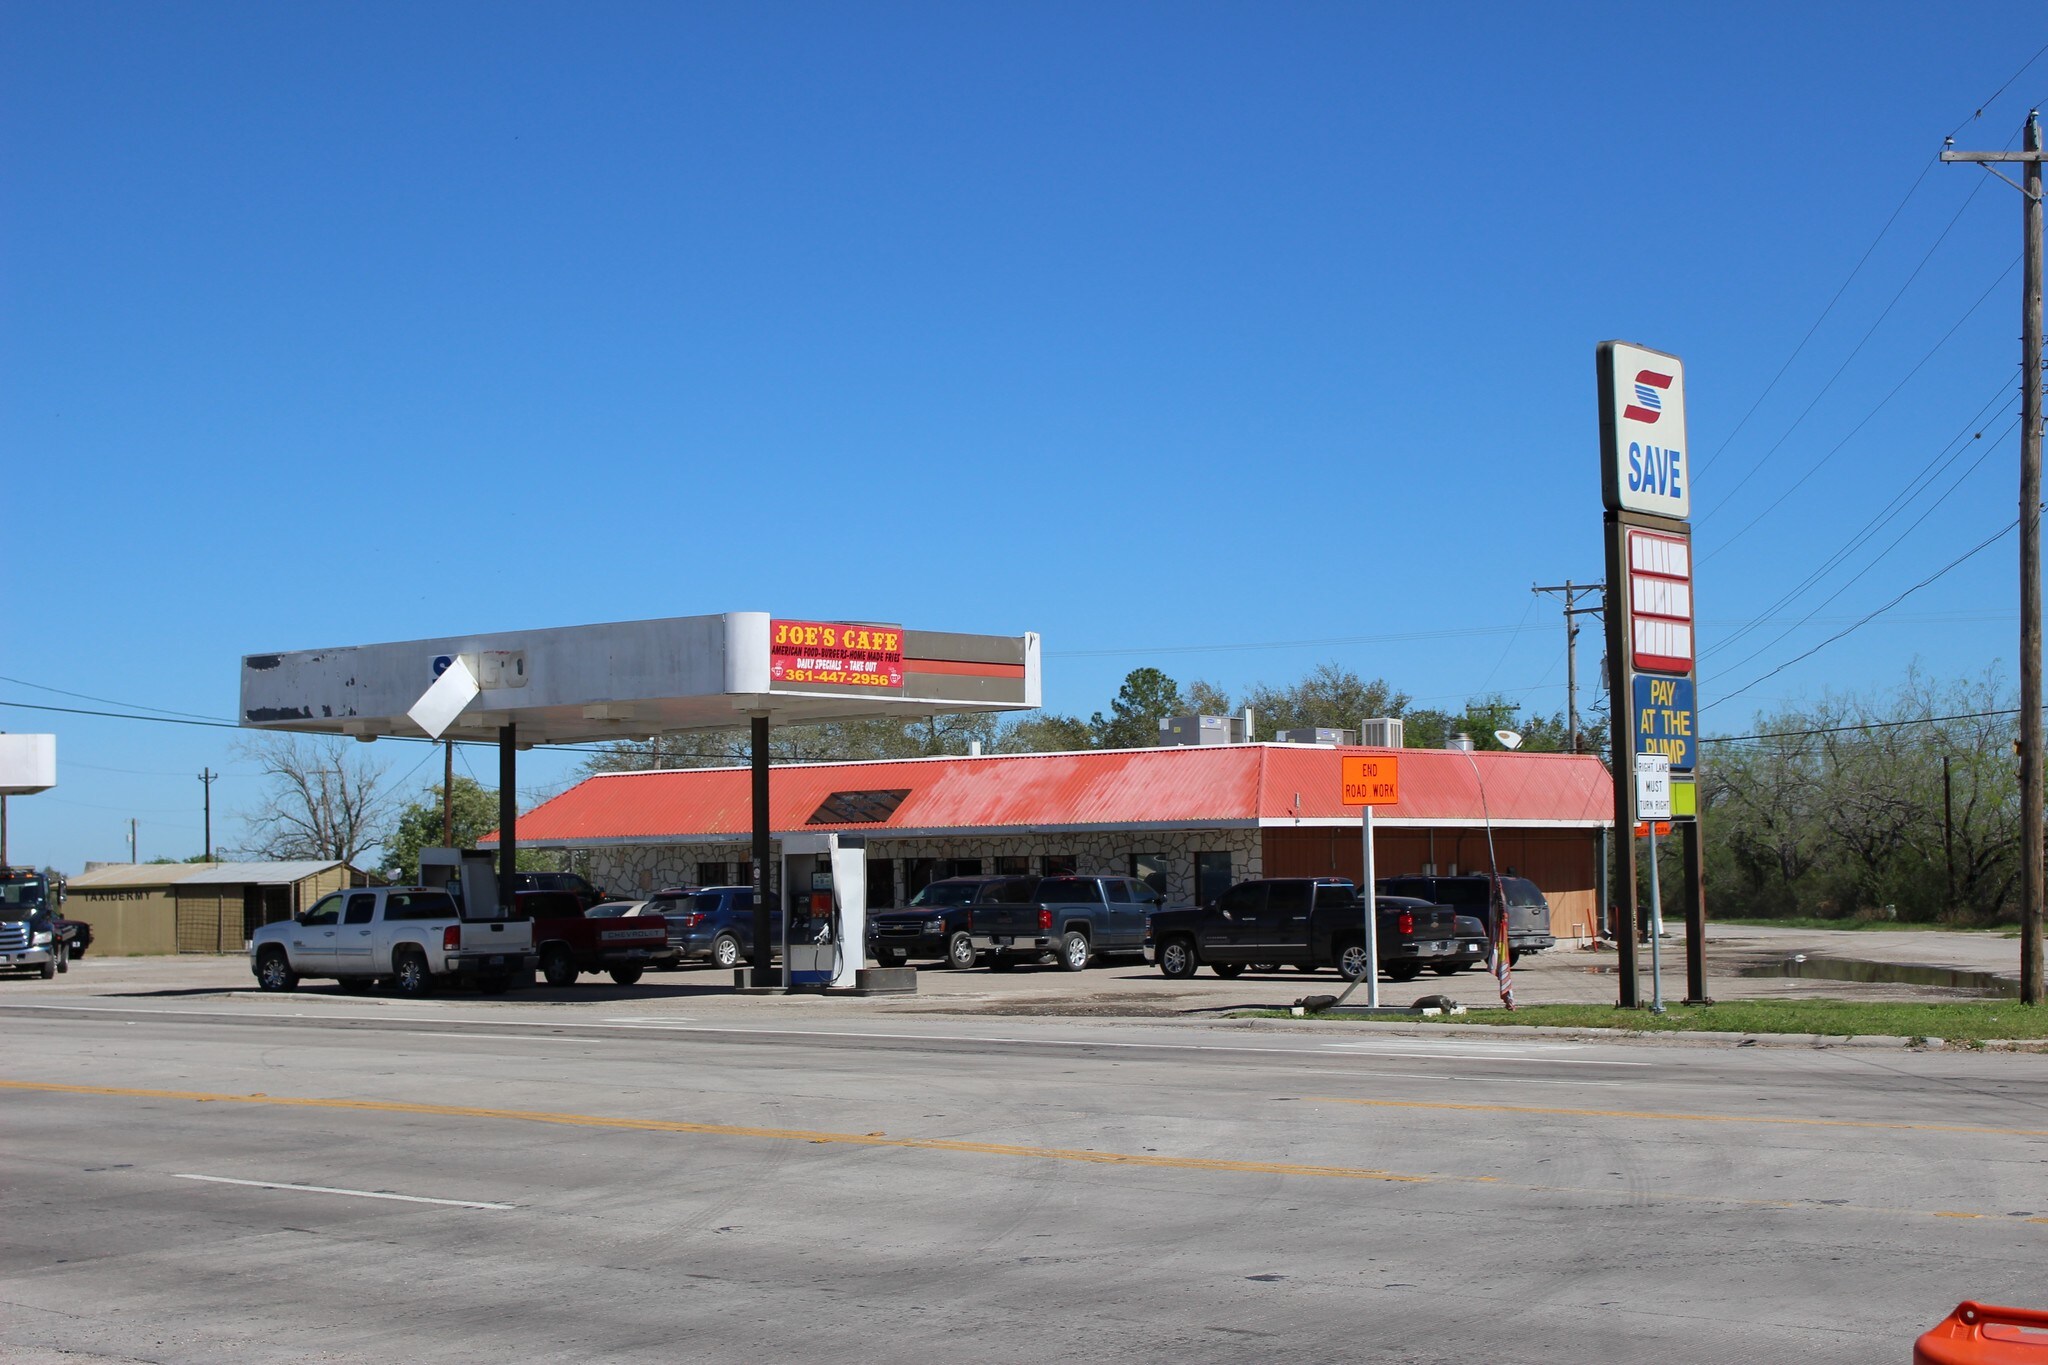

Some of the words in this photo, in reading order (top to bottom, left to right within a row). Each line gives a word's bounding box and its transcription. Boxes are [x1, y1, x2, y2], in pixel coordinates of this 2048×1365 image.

[1628, 441, 1681, 499] SAVE
[775, 625, 836, 647] JOE'S
[842, 629, 898, 651] CAFE
[771, 645, 803, 656] AMERICAN
[867, 651, 884, 661] MADE
[885, 653, 900, 662] FRIES
[797, 658, 815, 669] DAILY
[815, 659, 842, 670] SPECIALS
[850, 661, 864, 672] TAKE
[865, 661, 877, 672] OUT
[786, 669, 889, 685] 361-447-2956
[1651, 679, 1676, 706] PAY
[1640, 709, 1656, 734] AT
[1661, 711, 1692, 736] THE
[1362, 763, 1377, 777] END
[1638, 762, 1654, 773] RIGHT
[1656, 763, 1669, 773] LANE
[1345, 784, 1367, 797] ROAD
[1372, 784, 1395, 797] WORK
[1646, 781, 1662, 793] MUST
[1640, 800, 1654, 810] TURN
[1655, 800, 1669, 810] RIGHT
[84, 889, 151, 902] TAXIDERMY
